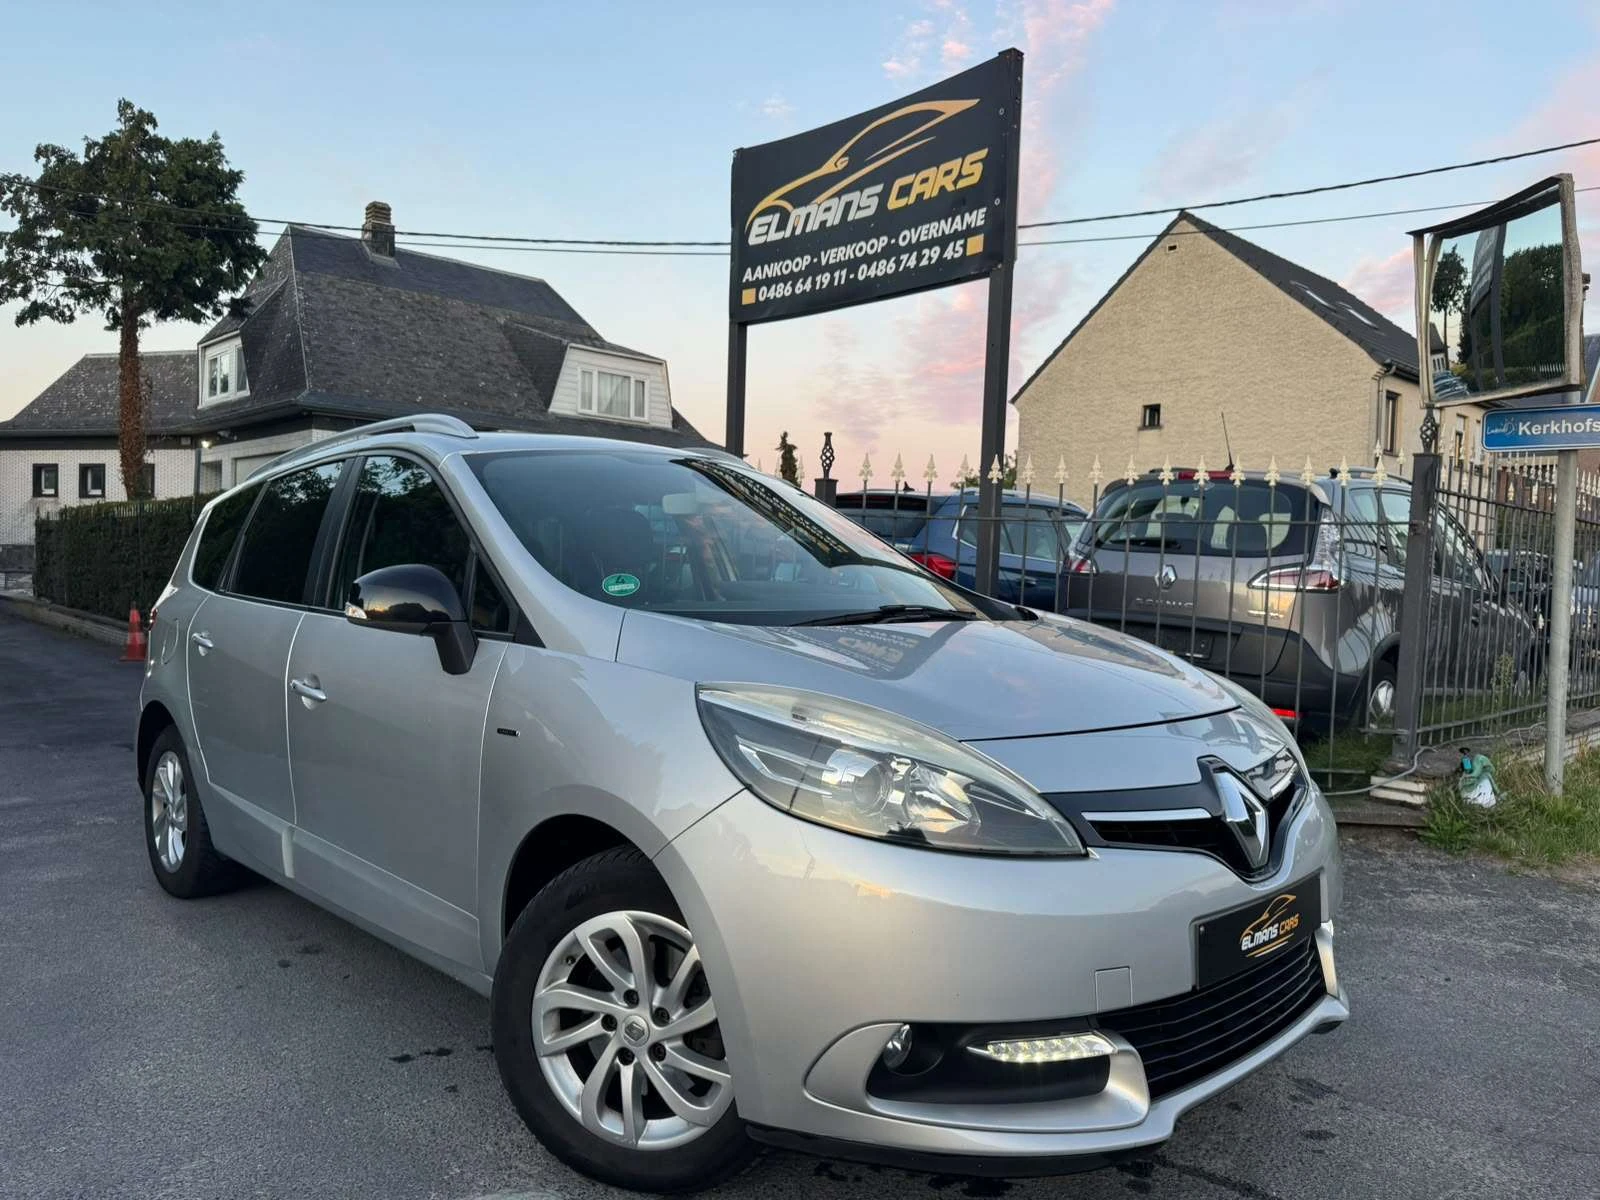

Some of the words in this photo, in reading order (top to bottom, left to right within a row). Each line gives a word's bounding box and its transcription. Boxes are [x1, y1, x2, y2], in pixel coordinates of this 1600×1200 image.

[748, 184, 884, 246] ELMANS
[887, 148, 989, 210] CARS
[742, 255, 811, 283] AANKOOP
[820, 236, 888, 266] VERKOOP
[898, 207, 987, 247] OVERNAME
[758, 282, 792, 302] 0486
[794, 275, 813, 295] 64
[815, 272, 831, 291] 19
[833, 268, 847, 287] 11
[857, 256, 896, 281] 0486
[898, 250, 917, 272] 74
[919, 246, 941, 267] 29
[942, 239, 966, 261] 45
